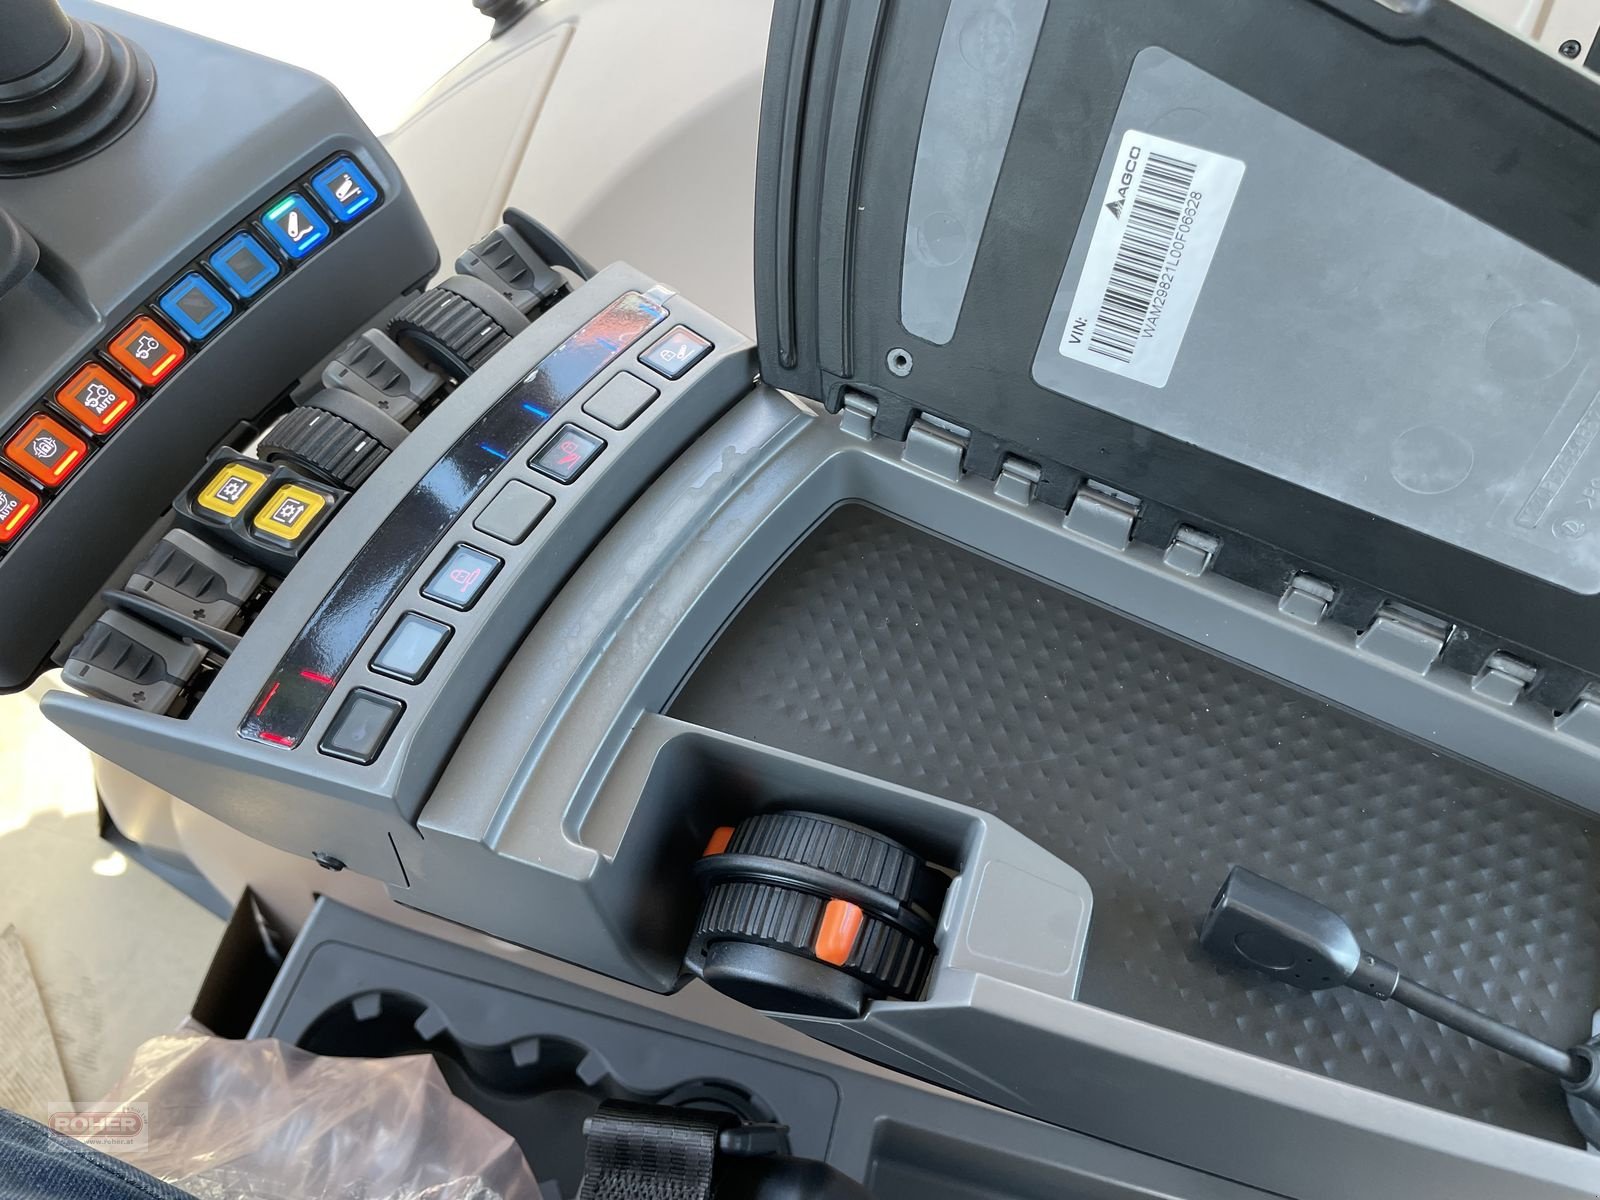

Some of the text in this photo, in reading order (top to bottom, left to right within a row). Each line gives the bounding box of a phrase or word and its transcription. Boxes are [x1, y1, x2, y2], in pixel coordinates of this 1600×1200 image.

[1118, 146, 1142, 198] AGCO
[1141, 191, 1202, 339] WAM29821L00F06628
[1068, 317, 1088, 344] VIN:
[95, 393, 116, 414] AUTO
[0, 500, 18, 521] AUTO
